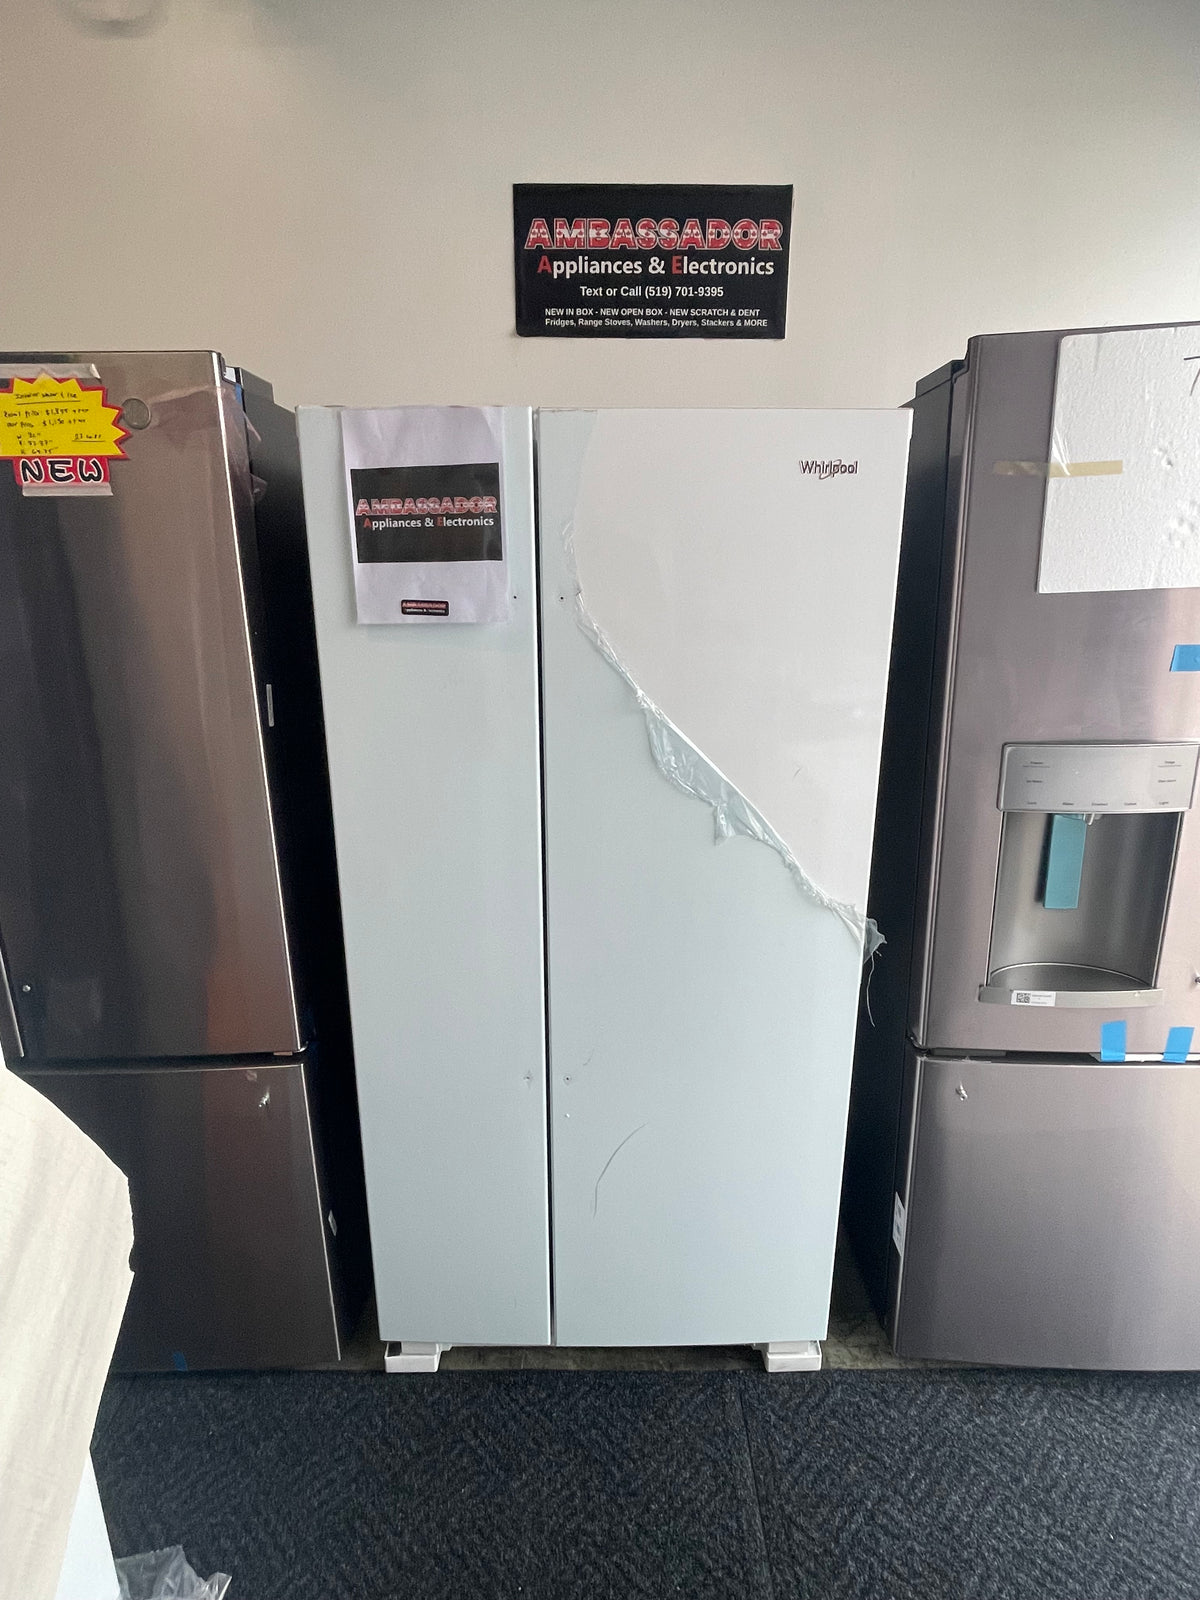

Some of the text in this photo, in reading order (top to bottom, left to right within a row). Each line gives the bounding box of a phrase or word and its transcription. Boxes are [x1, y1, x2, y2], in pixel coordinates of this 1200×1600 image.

[524, 217, 783, 251] AMBASSADOR
[536, 255, 775, 279] Appliances & Electronics
[579, 285, 724, 299] Text or Call (519) 701-9395
[544, 308, 564, 316] NEW
[565, 308, 575, 316] IN
[576, 308, 594, 316] BOX
[600, 308, 619, 316] NEW
[620, 308, 644, 316] OPEN
[645, 308, 663, 316] BOX
[669, 308, 689, 317] NEW
[690, 308, 729, 317] SCRATCH
[730, 308, 736, 317] &
[738, 308, 761, 317] DENT
[545, 318, 768, 329] Fridges, Range Stoves, Washers, Dryers, Stackers & MORE
[20, 458, 105, 484] NEW
[798, 460, 859, 477] Whirlpool
[355, 496, 498, 516] AMBASSADOR
[363, 516, 495, 531] Appliances & Electronics
